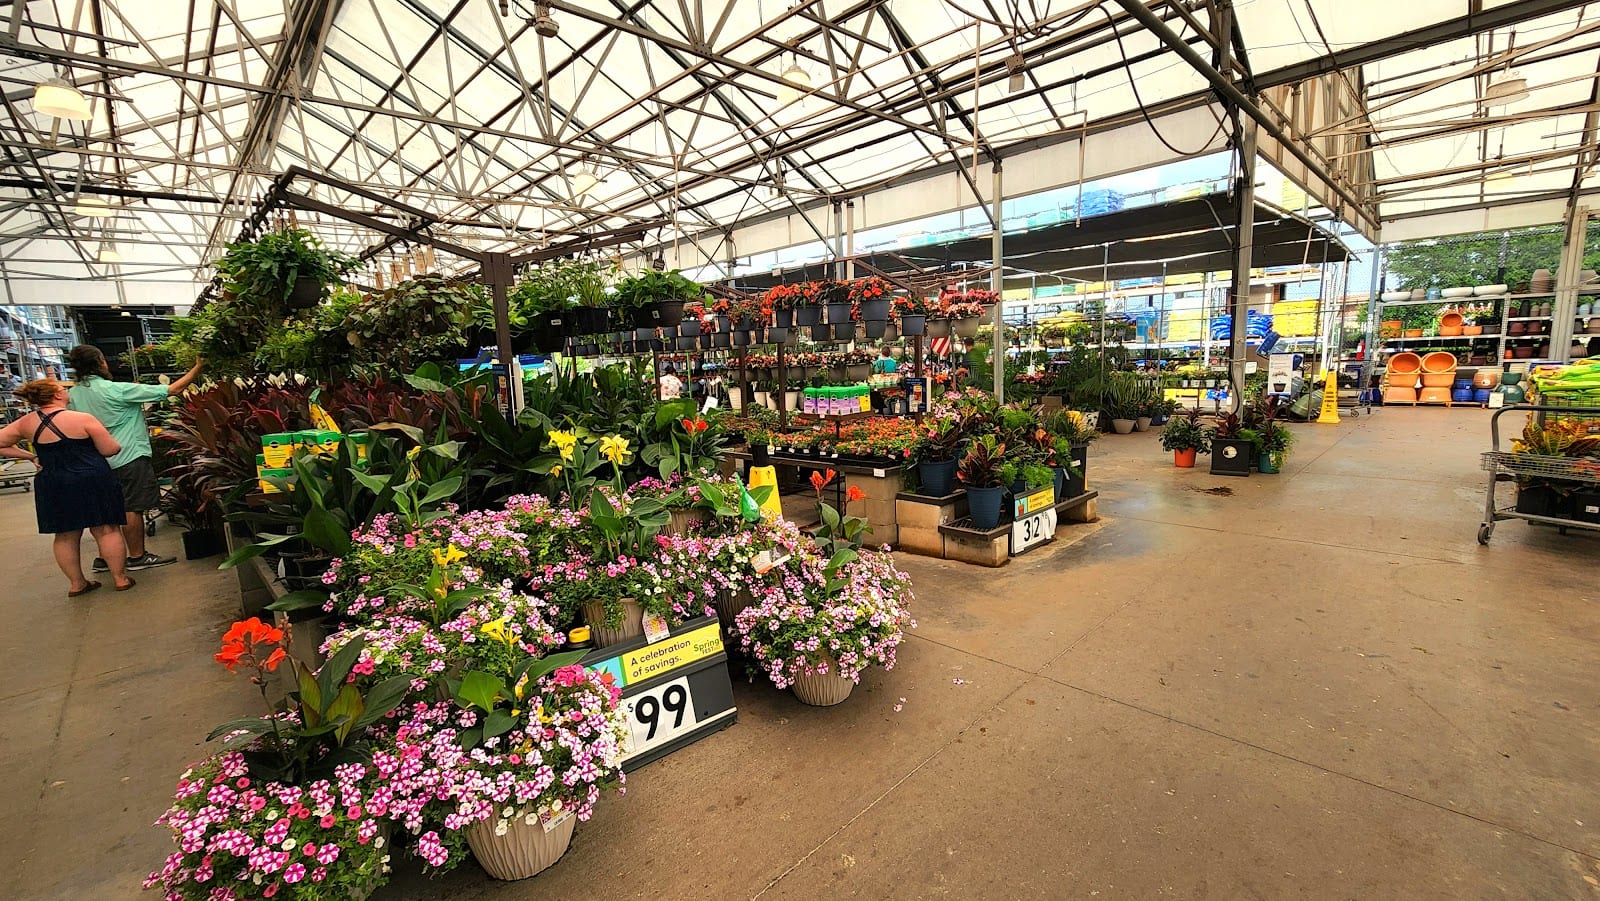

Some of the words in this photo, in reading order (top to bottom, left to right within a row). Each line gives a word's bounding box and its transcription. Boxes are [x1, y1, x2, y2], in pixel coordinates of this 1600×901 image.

[1024, 516, 1040, 542] 32
[630, 657, 638, 666] A
[640, 640, 691, 663] celebration
[693, 638, 720, 652] Spring
[702, 646, 714, 655] FEST
[632, 668, 642, 678] of
[644, 656, 682, 674] savings.
